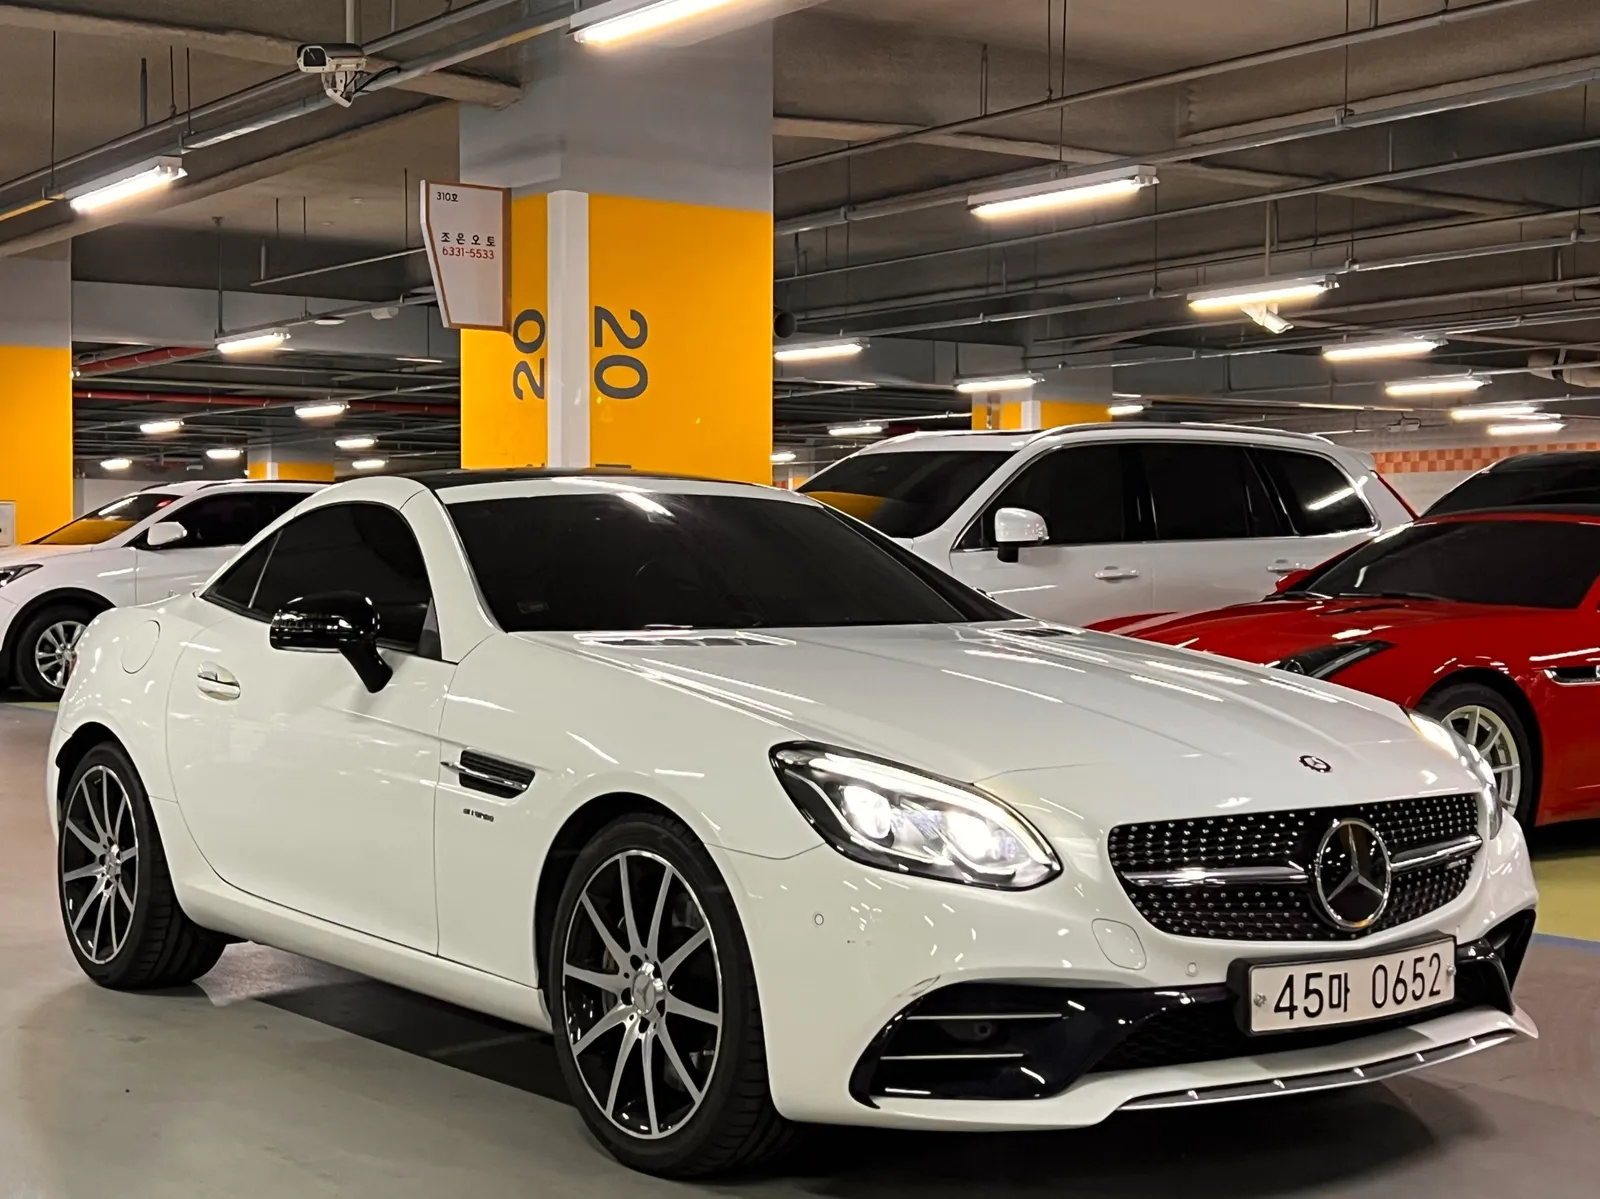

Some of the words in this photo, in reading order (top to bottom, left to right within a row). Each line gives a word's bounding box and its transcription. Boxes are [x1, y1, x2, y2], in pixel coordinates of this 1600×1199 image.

[436, 191, 459, 203] 310호
[442, 246, 495, 260] 6331-5533
[512, 308, 546, 401] 20
[594, 305, 649, 400] 20
[1273, 971, 1351, 1020] 45마
[1371, 952, 1442, 1009] 0652
